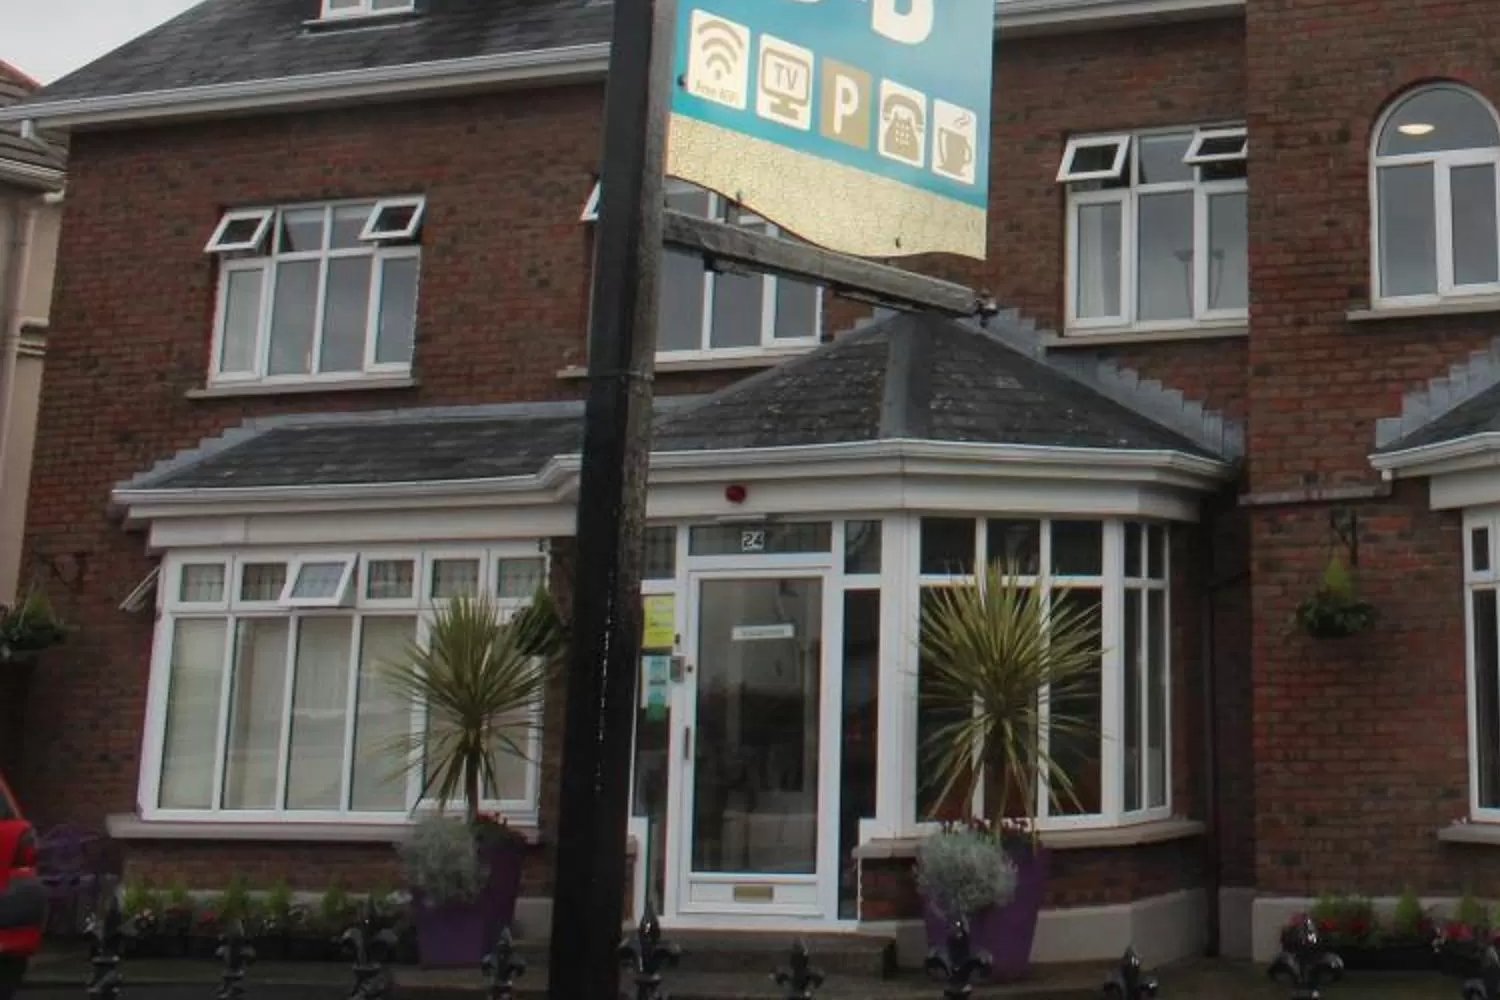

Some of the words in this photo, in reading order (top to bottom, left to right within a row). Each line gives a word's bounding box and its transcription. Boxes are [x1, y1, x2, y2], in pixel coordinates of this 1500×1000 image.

[773, 61, 798, 91] TV
[833, 74, 859, 134] P
[741, 530, 765, 552] 24
